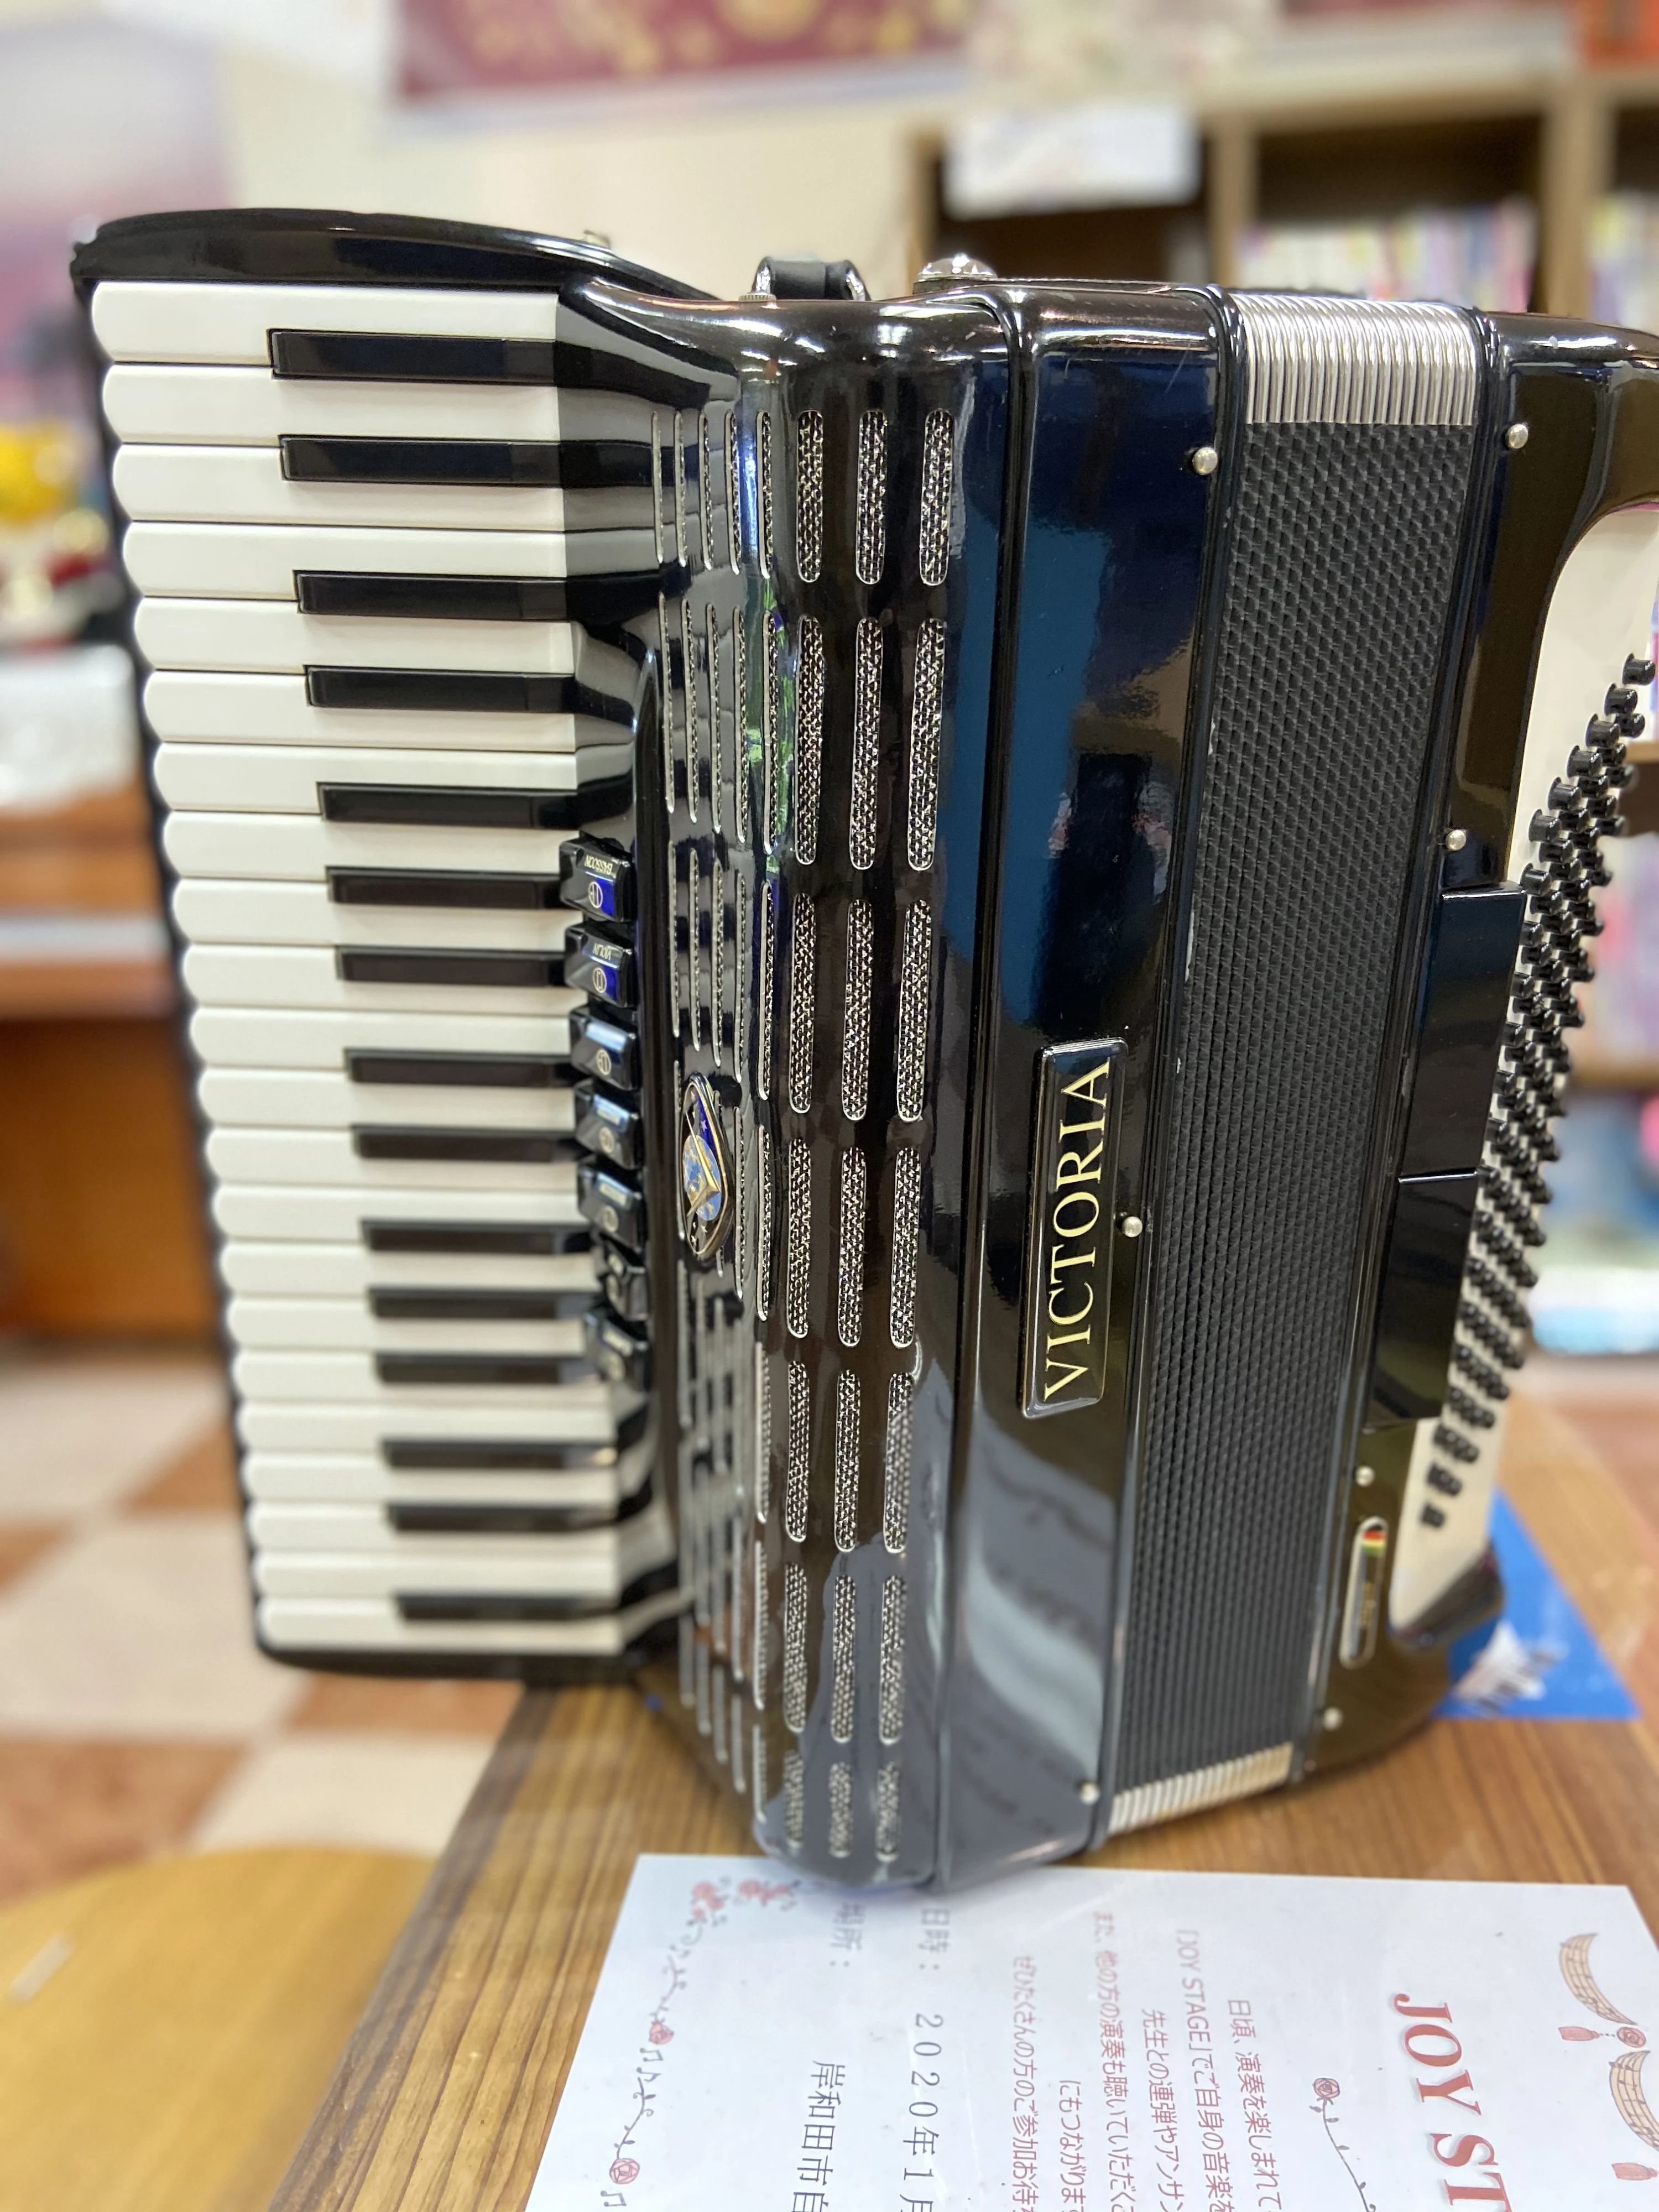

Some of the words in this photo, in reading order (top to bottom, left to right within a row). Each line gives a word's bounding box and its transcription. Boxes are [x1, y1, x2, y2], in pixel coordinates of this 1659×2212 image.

[584, 855, 613, 875] BASSOON
[1044, 1057, 1110, 1401] VICTORIA
[1228, 1999, 1283, 2212] 日頃、演奏を楽しまれて
[1393, 1993, 1482, 2116] JOY
